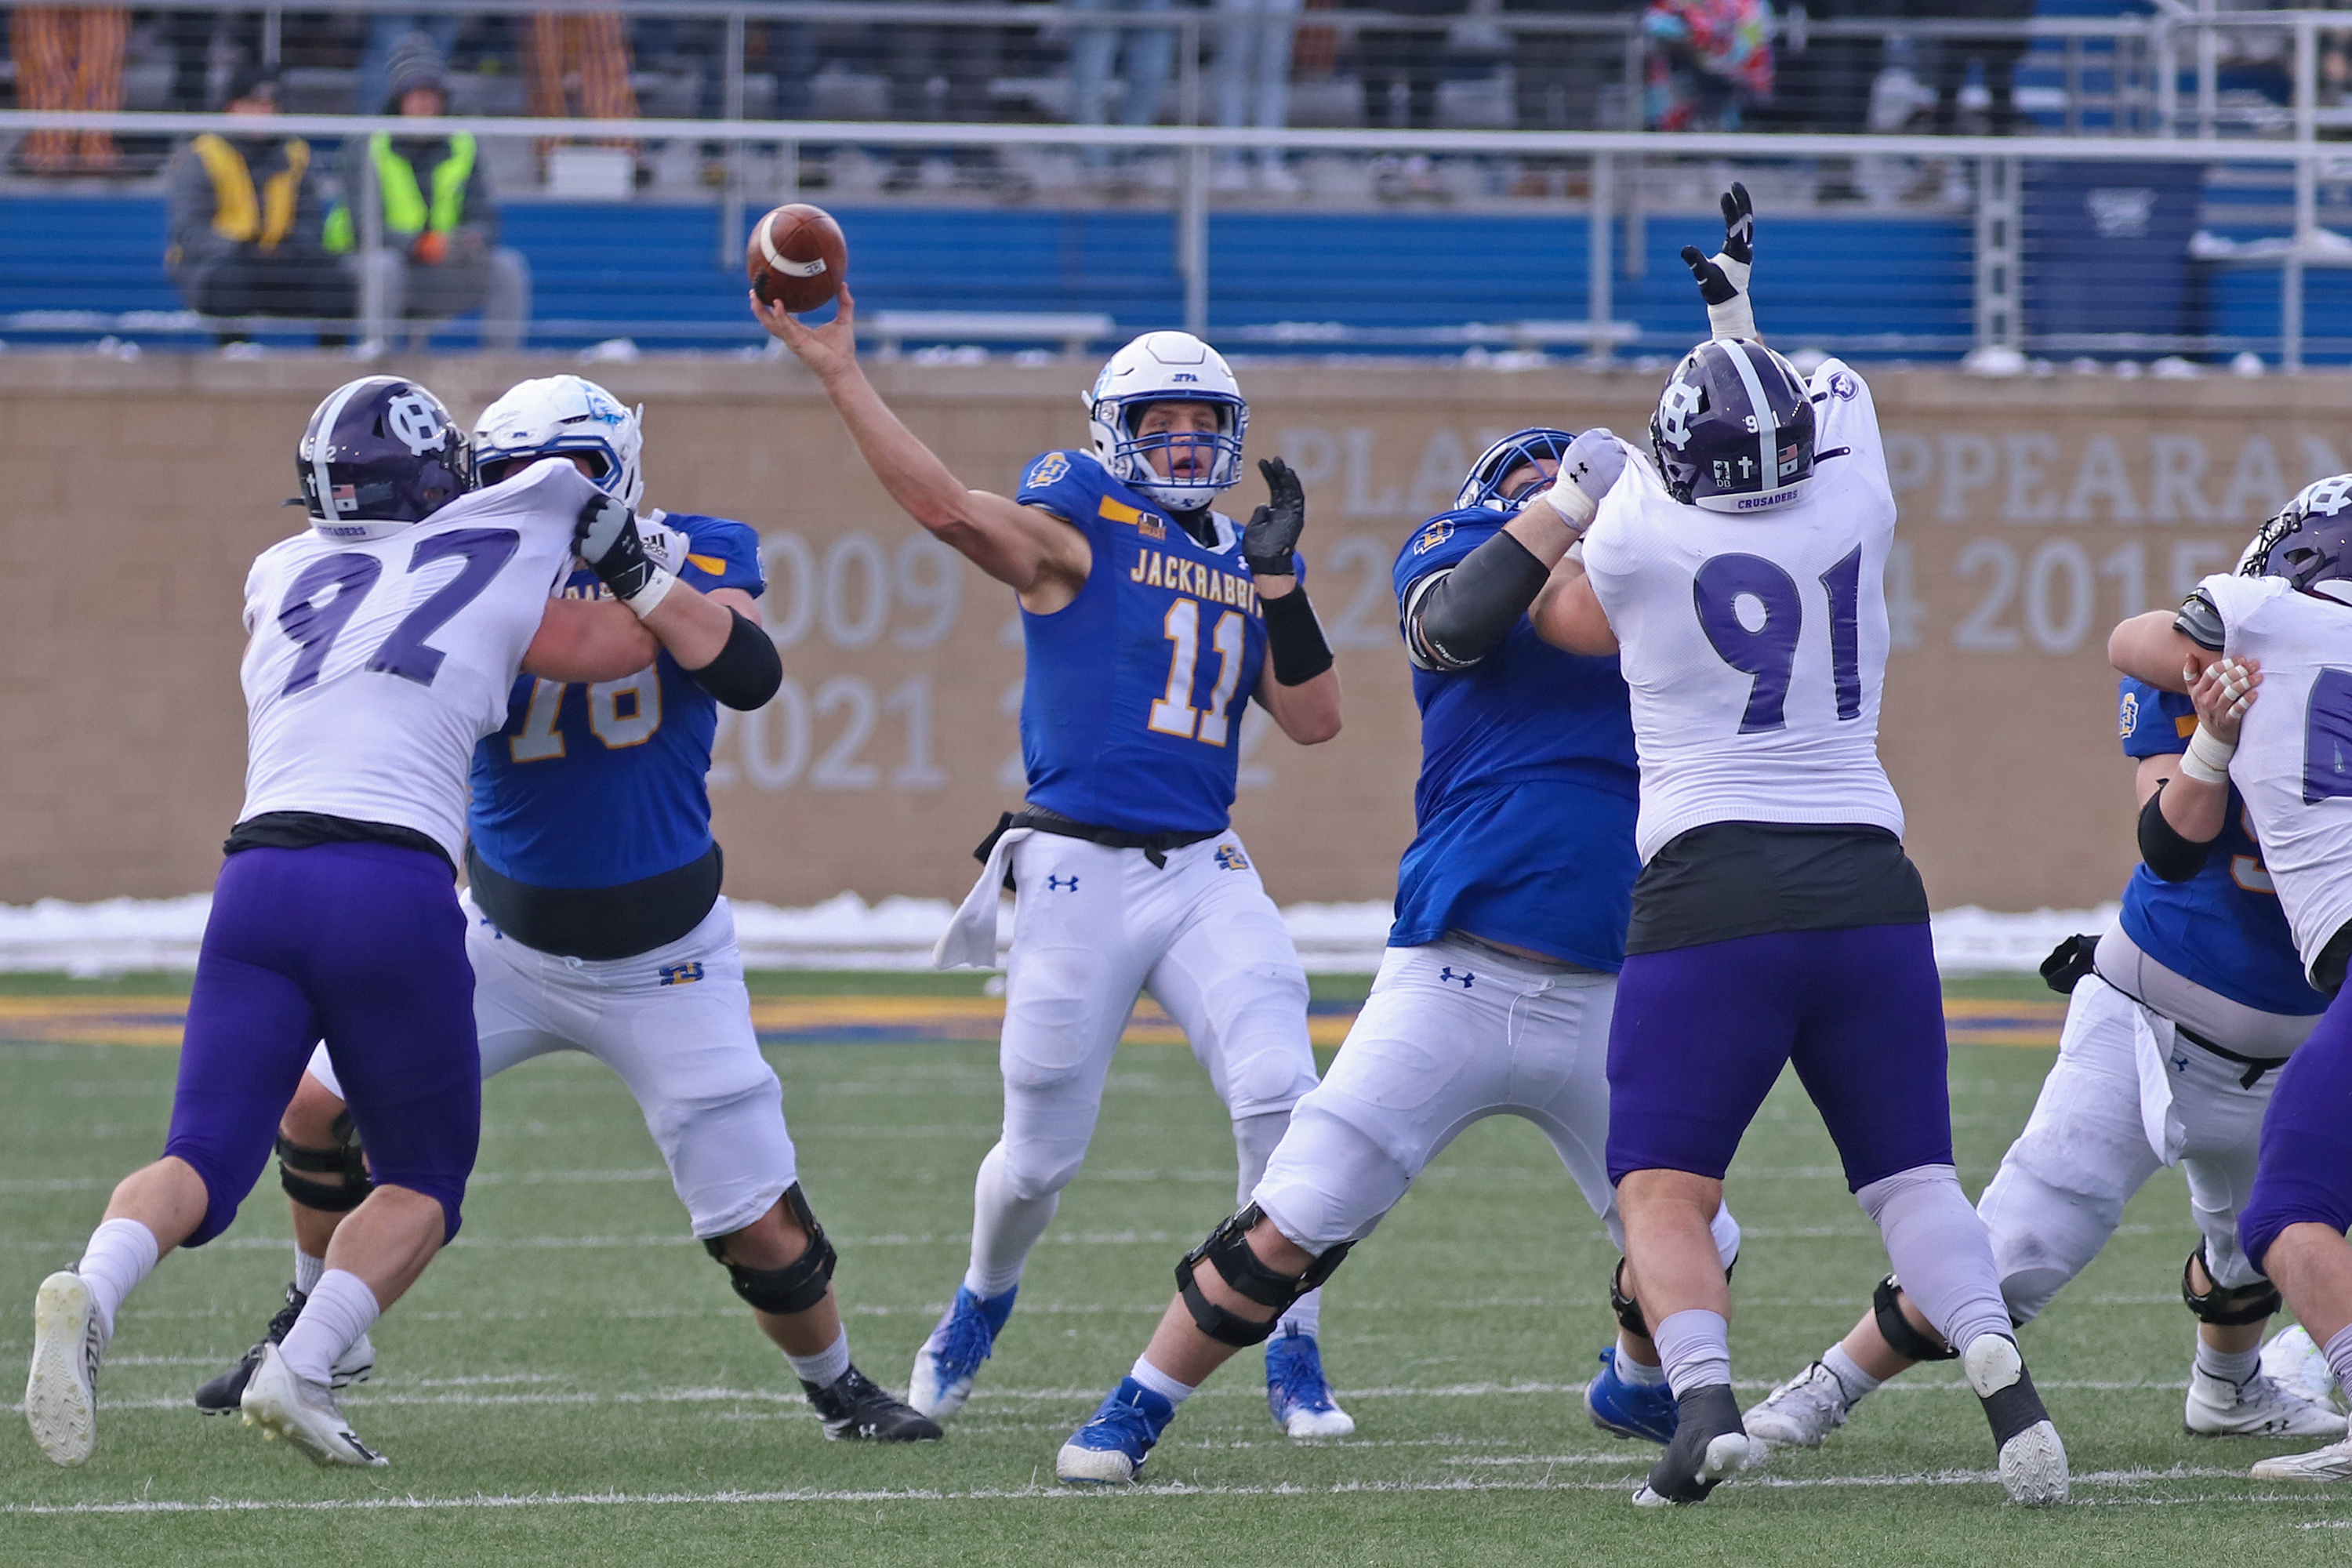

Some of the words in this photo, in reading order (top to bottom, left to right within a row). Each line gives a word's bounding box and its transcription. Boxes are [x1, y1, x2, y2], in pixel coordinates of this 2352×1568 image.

[1737, 489, 1798, 510] CRUSADERS
[278, 528, 521, 699] 92
[757, 532, 961, 652] 009
[1693, 542, 1863, 735] 91
[1148, 597, 1246, 747] 11
